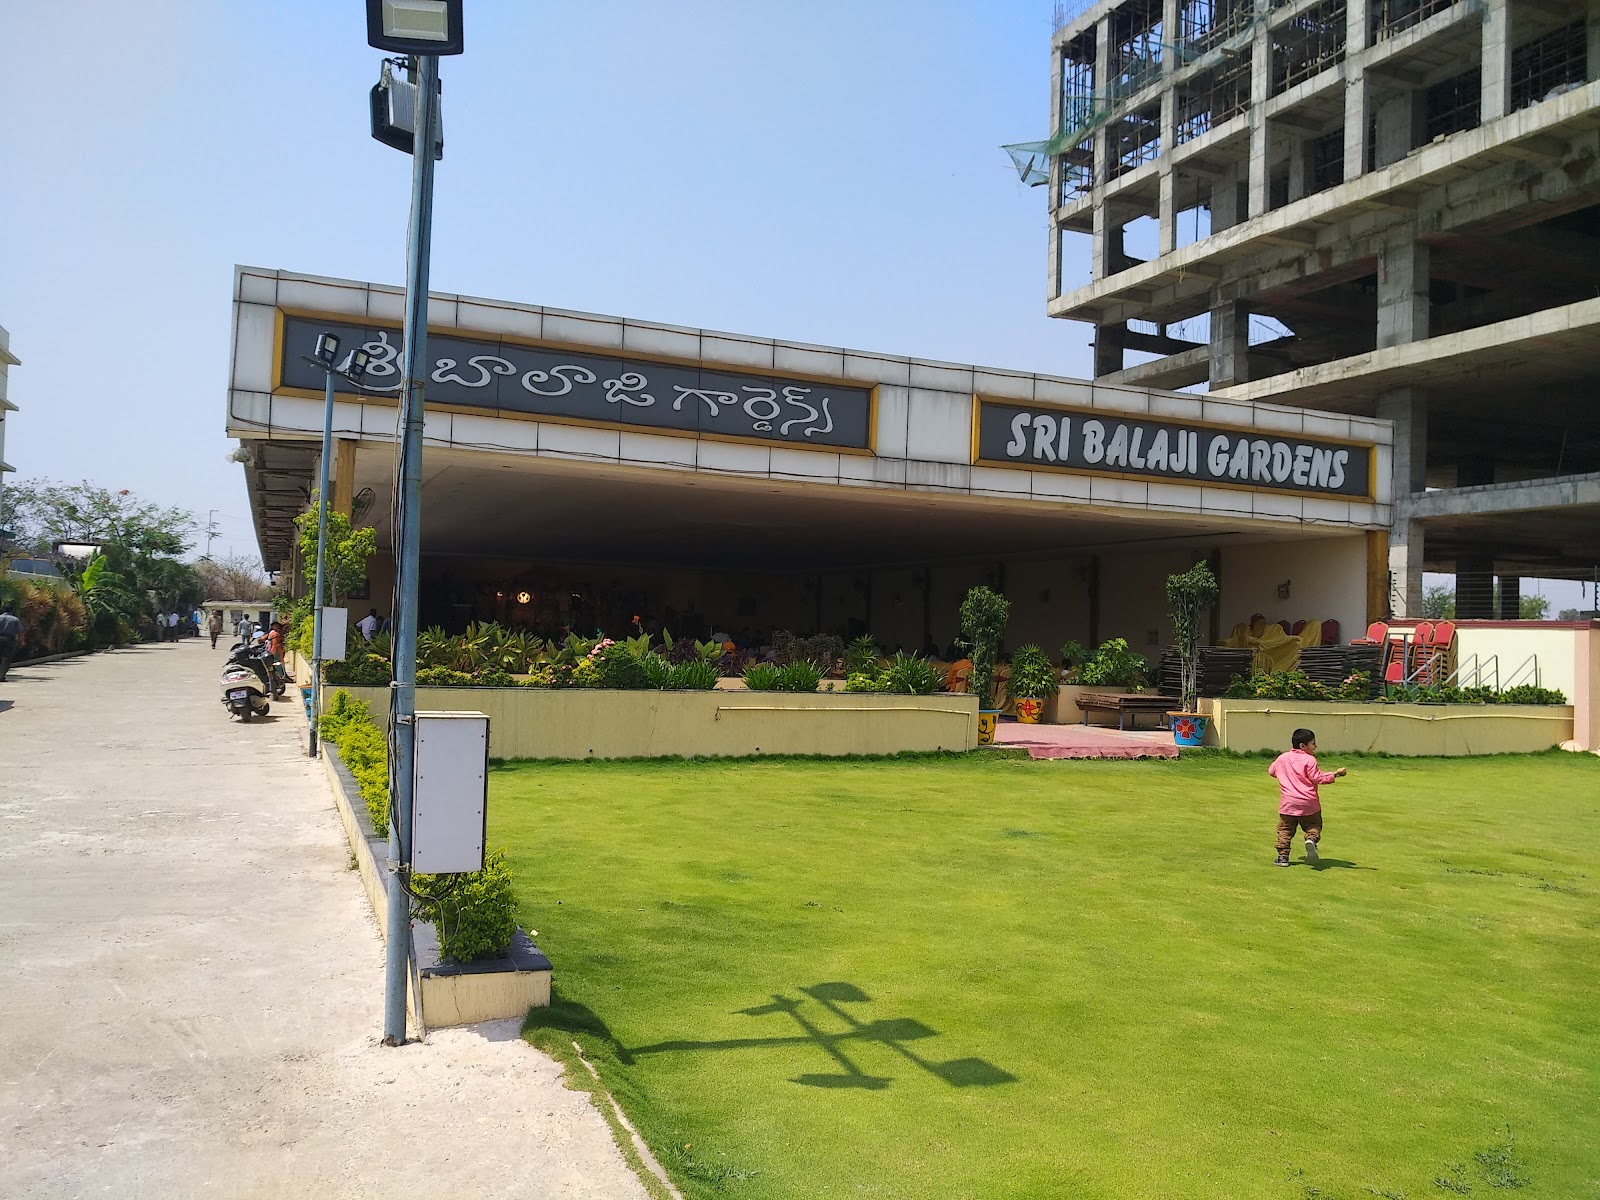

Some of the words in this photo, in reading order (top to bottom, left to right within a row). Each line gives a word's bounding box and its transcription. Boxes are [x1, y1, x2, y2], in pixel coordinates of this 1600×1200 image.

[431, 355, 656, 407] బాలాజి
[672, 384, 833, 437] గార్డెన్స్
[1006, 412, 1072, 462] SRI
[1082, 419, 1199, 474] BALAJI
[1207, 434, 1349, 489] GARDENS
